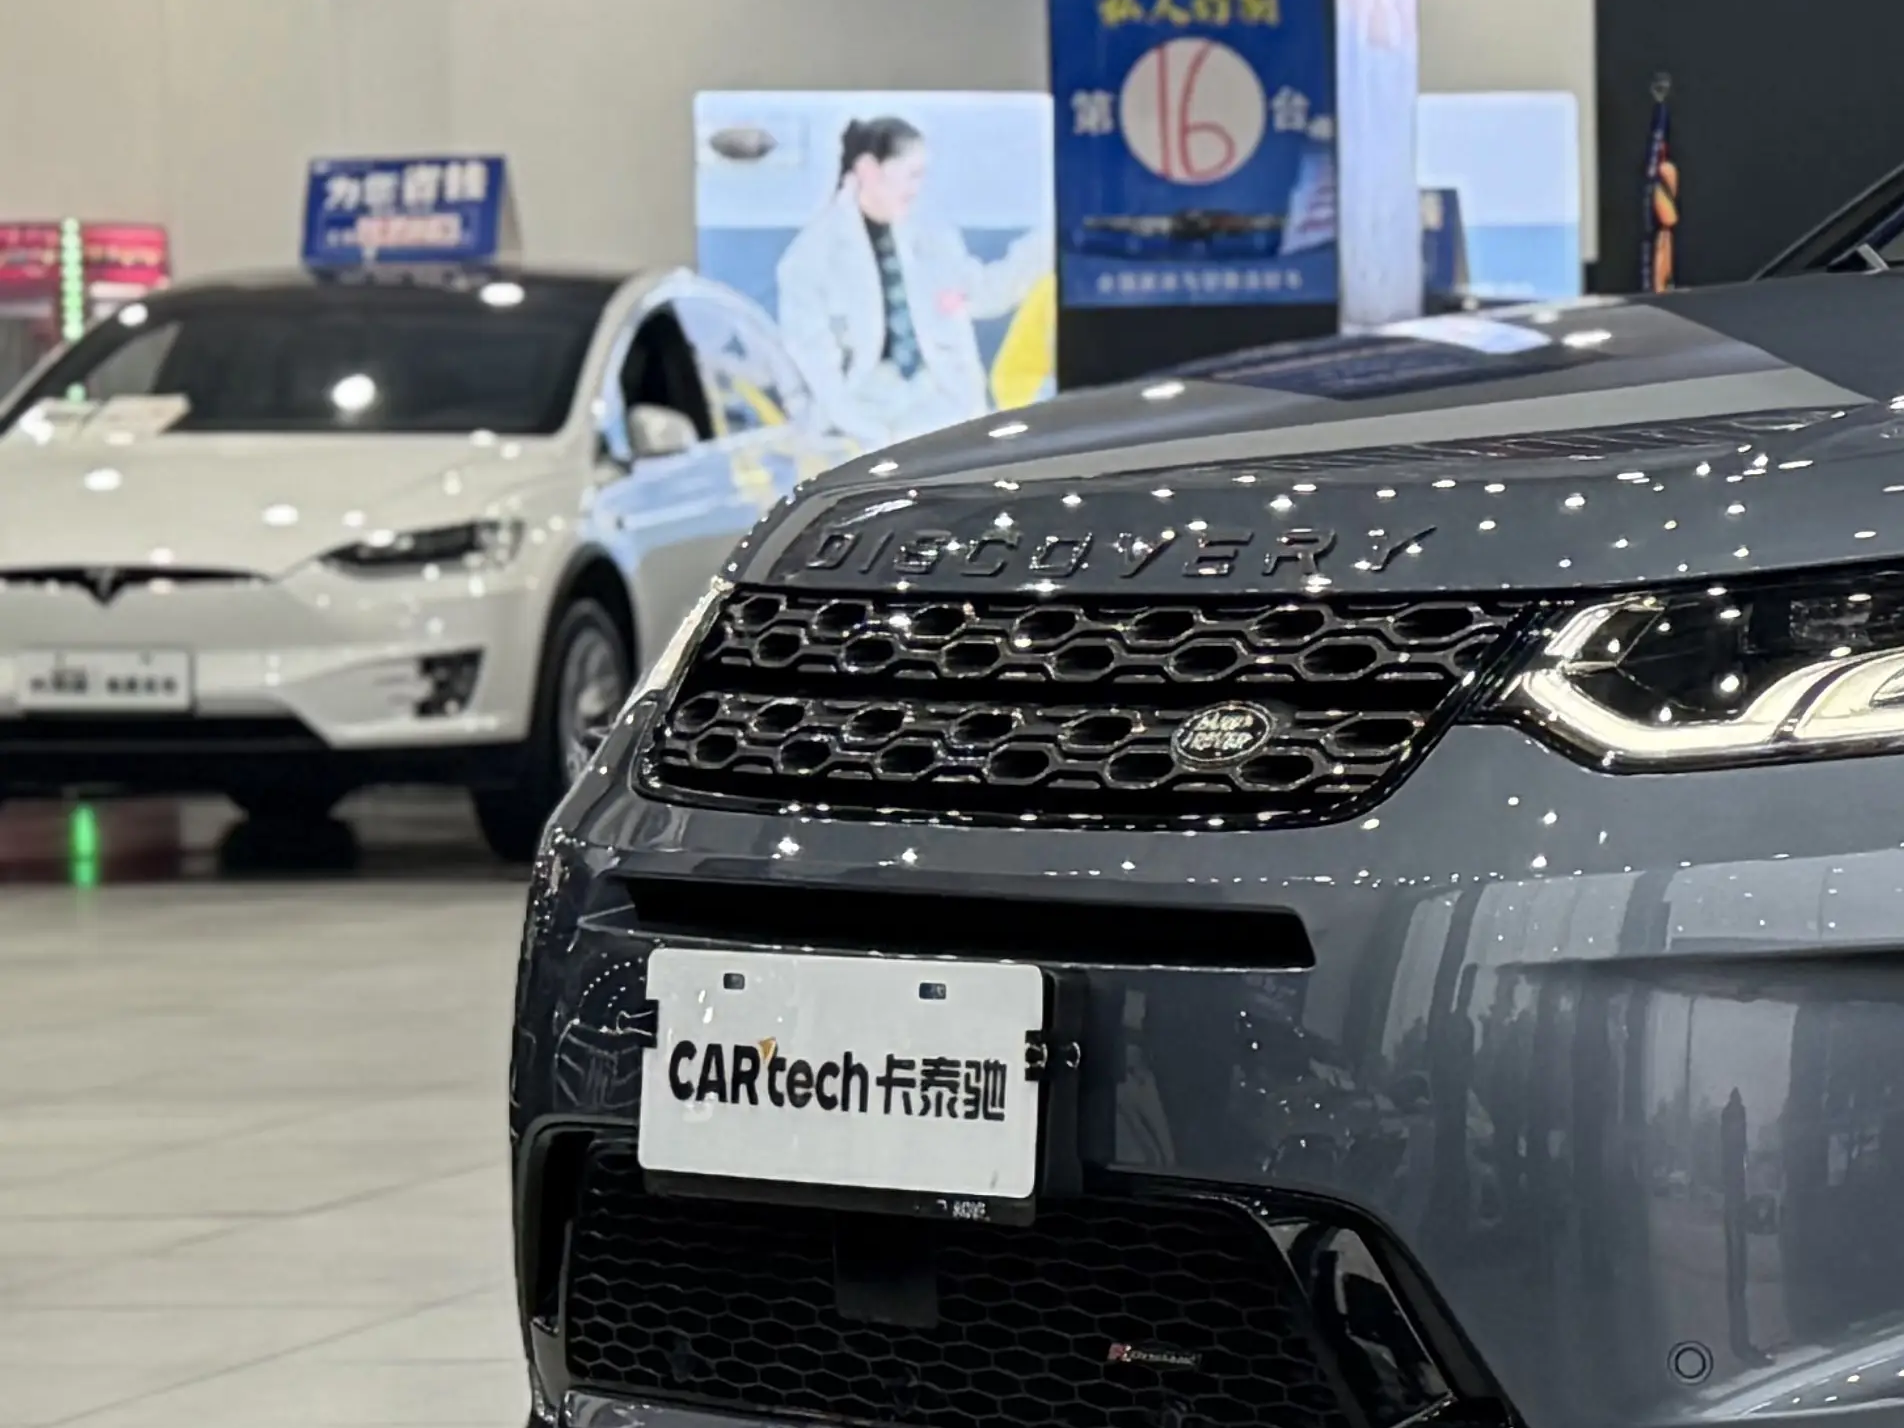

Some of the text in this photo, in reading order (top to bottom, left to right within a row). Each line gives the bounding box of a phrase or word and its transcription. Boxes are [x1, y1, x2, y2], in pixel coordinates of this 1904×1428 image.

[804, 525, 1440, 580] DISCOVERY
[668, 1038, 1008, 1122] CARtech 卡泰驰
